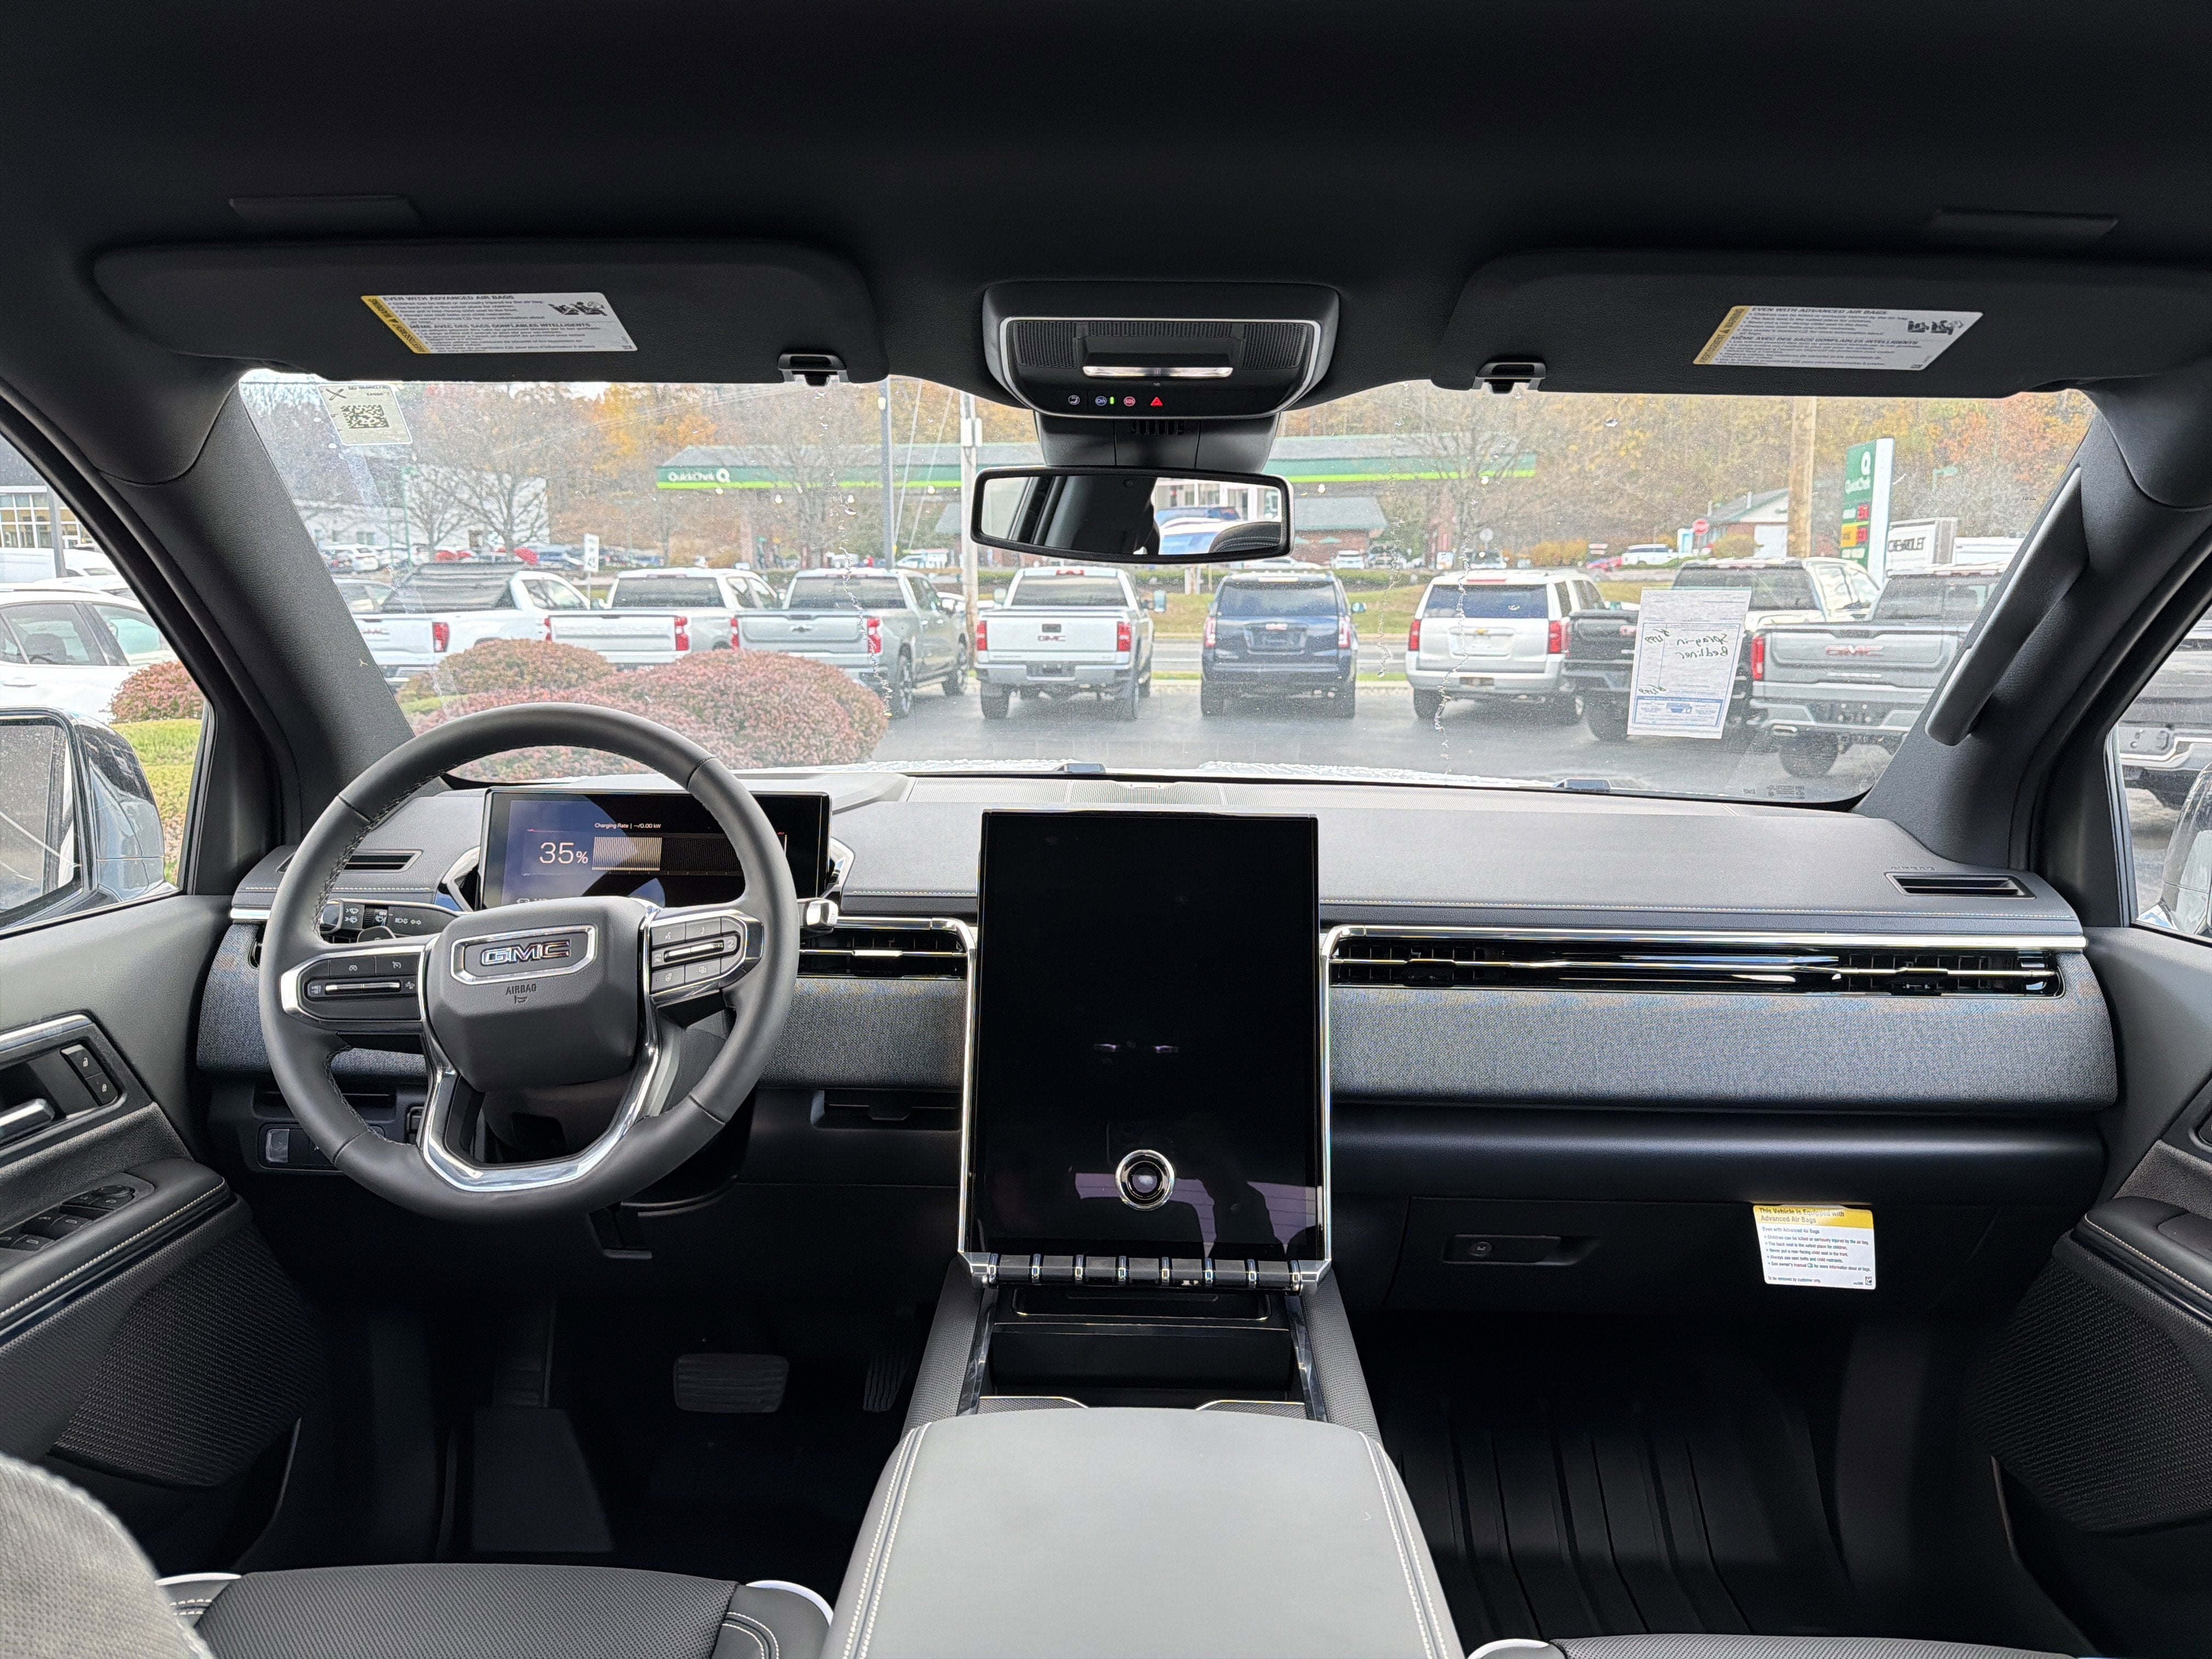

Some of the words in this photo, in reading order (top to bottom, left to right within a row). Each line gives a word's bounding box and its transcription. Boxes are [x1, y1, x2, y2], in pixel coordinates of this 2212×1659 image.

[1825, 645, 1884, 656] GMC
[481, 939, 571, 966] GMC
[506, 983, 537, 995] AIRBAG
